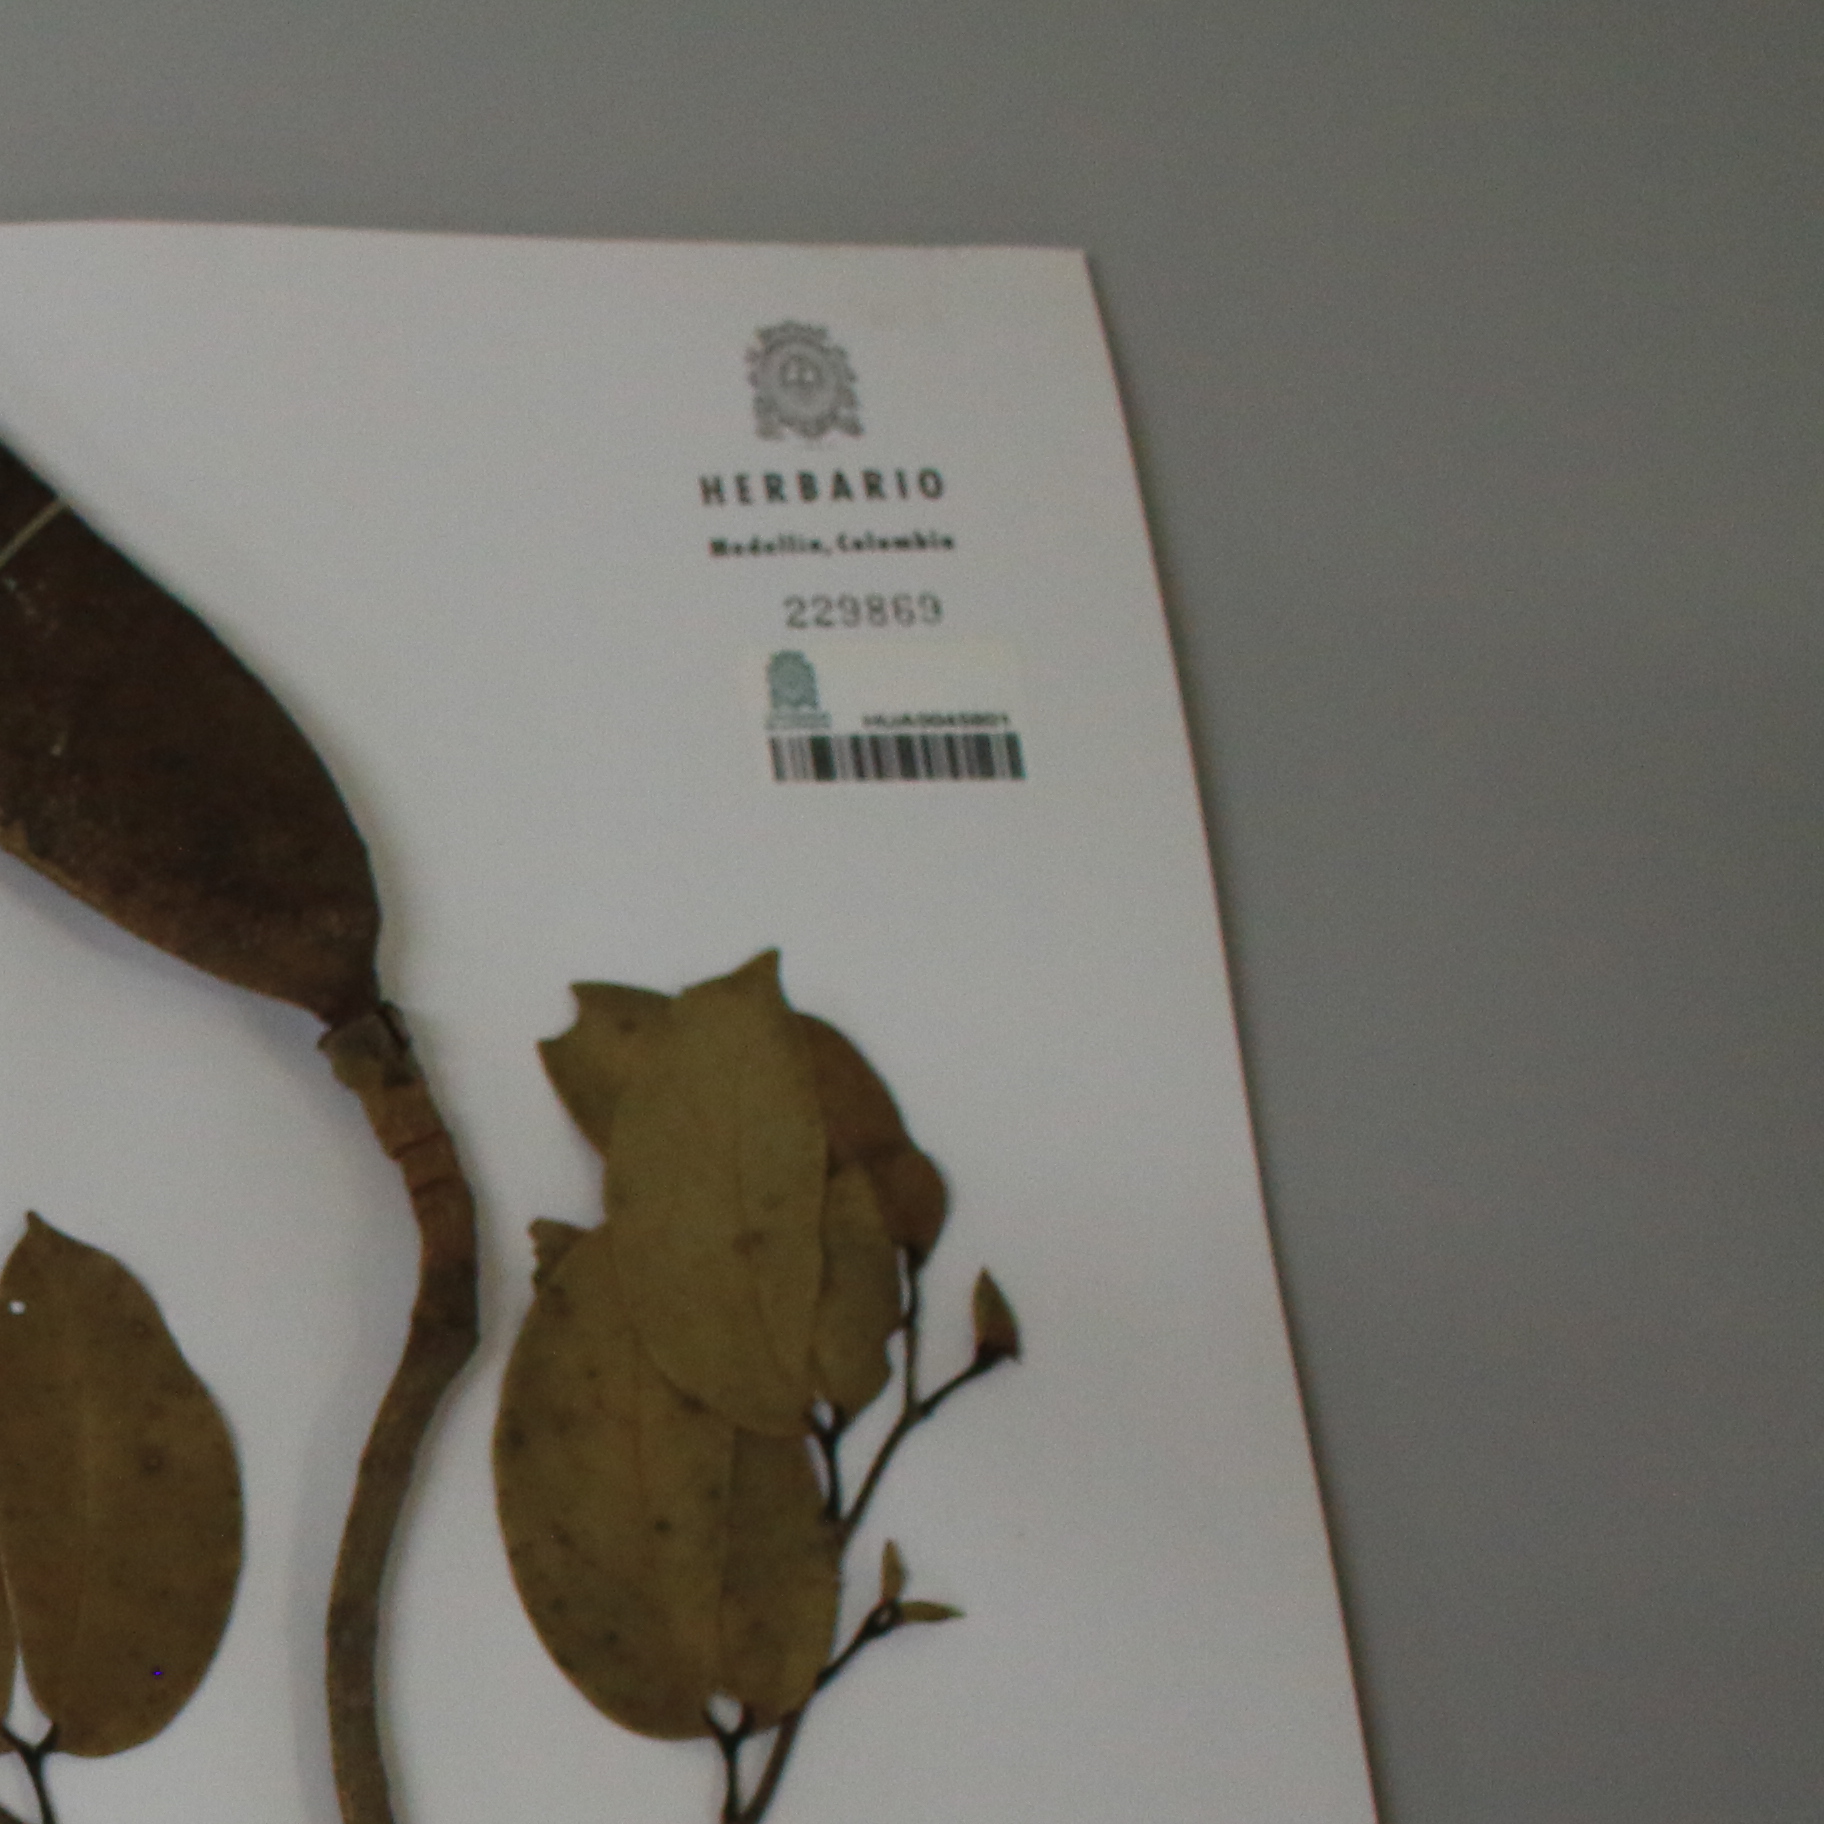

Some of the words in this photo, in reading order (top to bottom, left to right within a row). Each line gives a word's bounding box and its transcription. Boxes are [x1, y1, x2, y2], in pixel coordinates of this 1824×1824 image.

[699, 467, 945, 506] HERBARIO
[836, 531, 956, 553] Colombia
[783, 591, 944, 630] 229869
